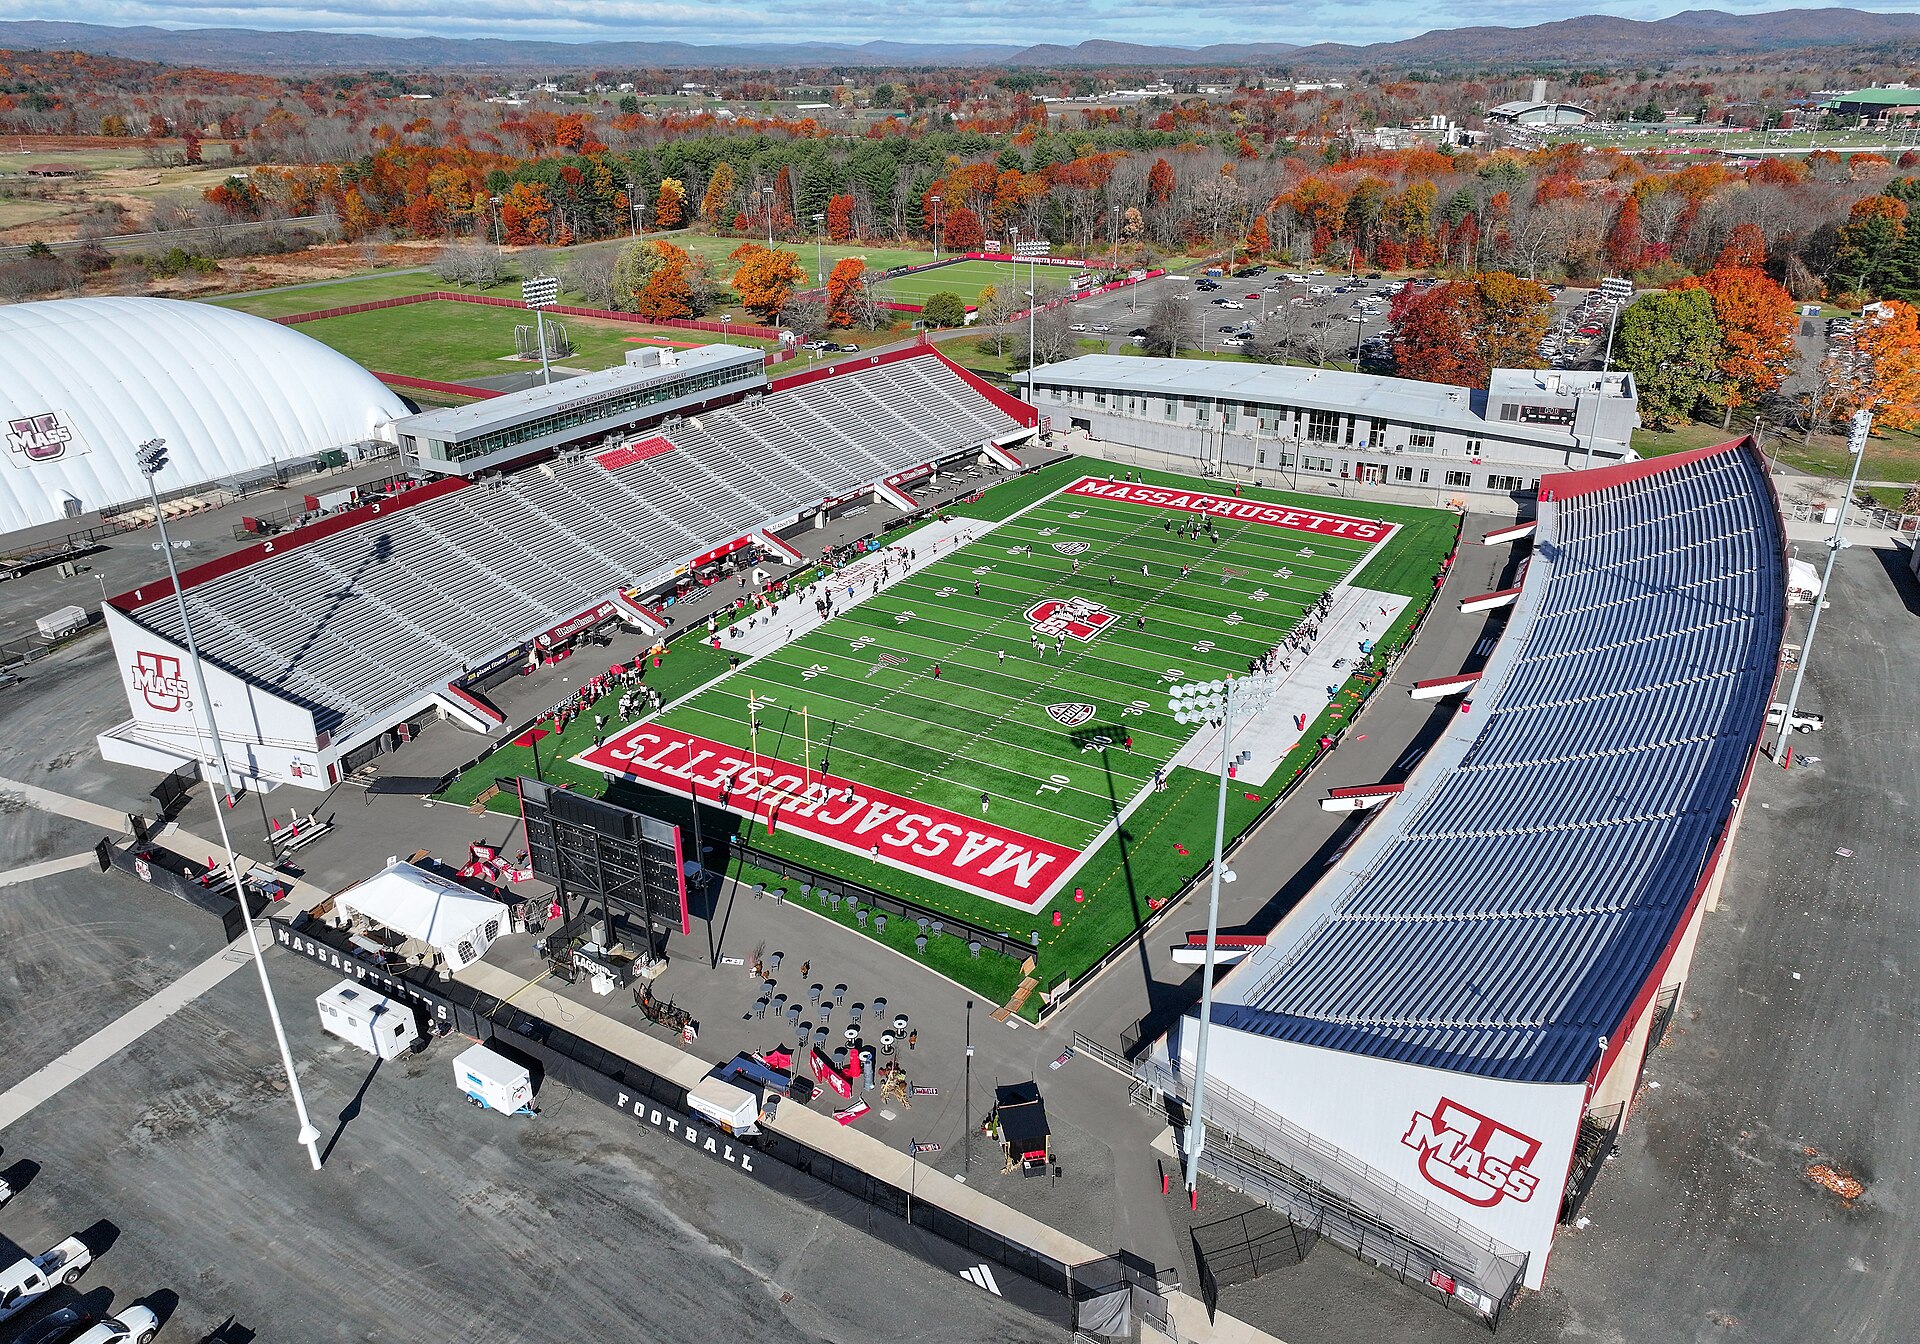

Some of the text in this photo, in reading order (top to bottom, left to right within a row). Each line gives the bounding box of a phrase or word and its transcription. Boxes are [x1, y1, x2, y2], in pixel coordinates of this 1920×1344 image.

[870, 356, 879, 364] 10
[828, 366, 835, 375] 9
[557, 401, 576, 411] MARTIN
[586, 393, 607, 404] RICHARD
[607, 387, 631, 399] JACOBSON
[667, 372, 687, 382] COMPLEX
[767, 382, 773, 391] 8
[6, 426, 72, 453] MASS
[372, 503, 380, 513] 3
[1076, 482, 1385, 539] MASSACHUSETTS
[263, 541, 275, 553] 2
[134, 589, 142, 601] 1
[1192, 640, 1216, 653] 50
[131, 665, 189, 700] MASS
[1162, 668, 1184, 683] 40
[1125, 700, 1150, 716] 30
[1085, 735, 1113, 753] 20
[1042, 774, 1070, 793] 10
[610, 733, 1056, 889] MASSACHUSETTS
[278, 929, 447, 1020] MASSACHUSETTS
[617, 1091, 754, 1172] FOOTBALL
[1400, 1110, 1541, 1203] MASS
